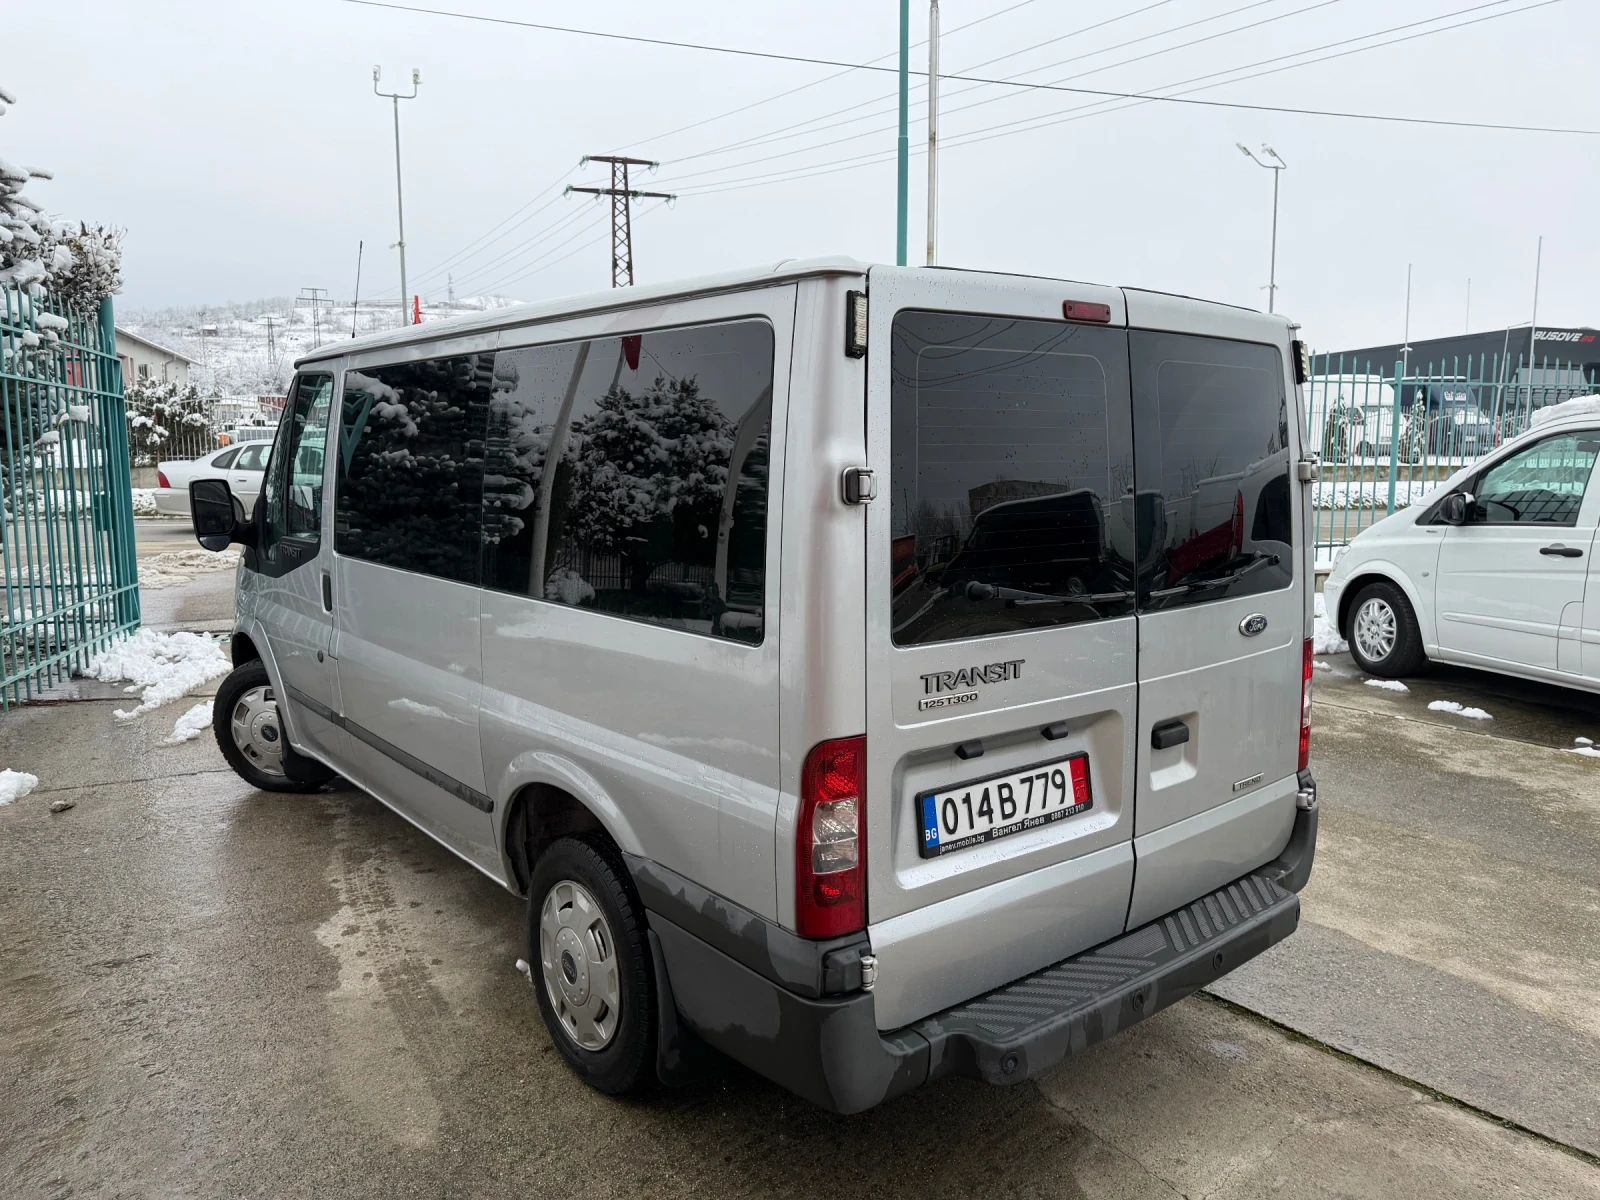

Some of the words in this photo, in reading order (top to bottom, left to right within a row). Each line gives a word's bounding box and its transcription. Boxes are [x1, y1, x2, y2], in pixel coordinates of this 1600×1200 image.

[1249, 617, 1265, 632] Ford
[920, 659, 1026, 694] TRANSIT
[942, 768, 1066, 835] 014B779
[925, 828, 938, 841] BG
[992, 822, 1022, 838] Вангел
[1023, 817, 1045, 829] Янев
